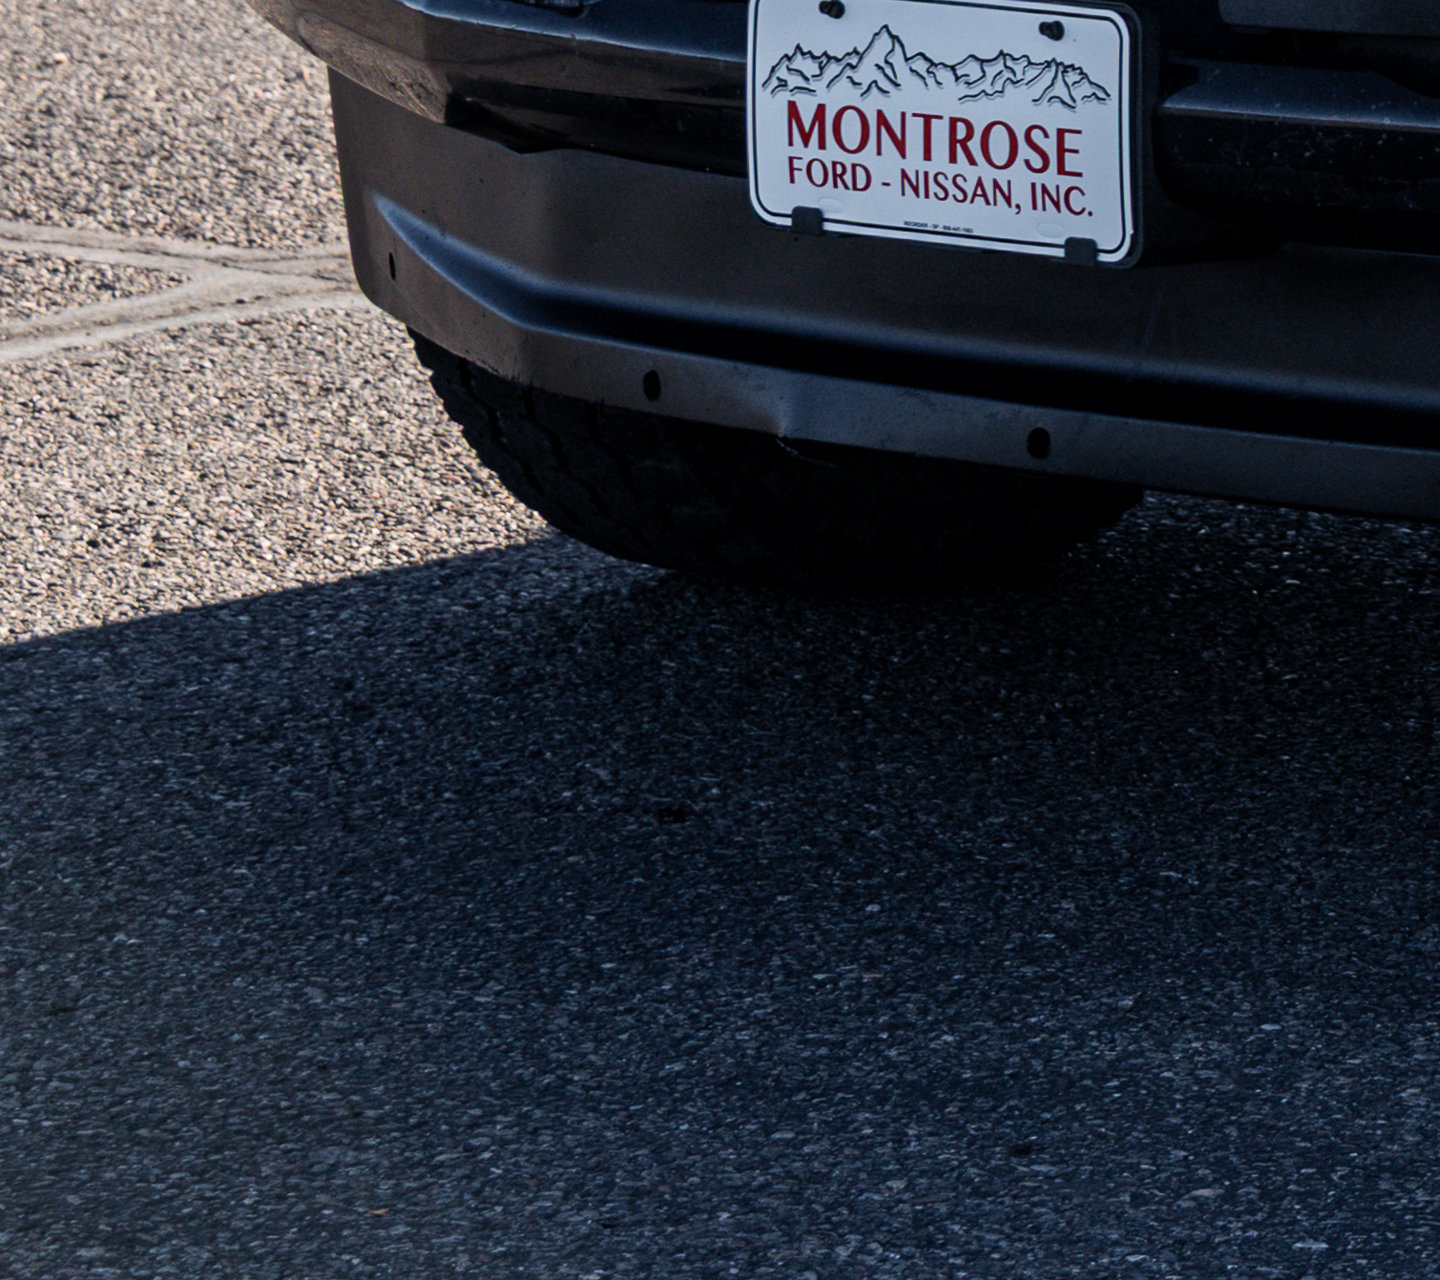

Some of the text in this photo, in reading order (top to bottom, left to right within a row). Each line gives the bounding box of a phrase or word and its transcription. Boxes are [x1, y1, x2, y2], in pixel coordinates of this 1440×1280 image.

[786, 99, 1084, 178] MONTROSE
[788, 155, 873, 192] FORD
[900, 168, 1022, 215] NISSAN,
[1030, 181, 1094, 218] INC.
